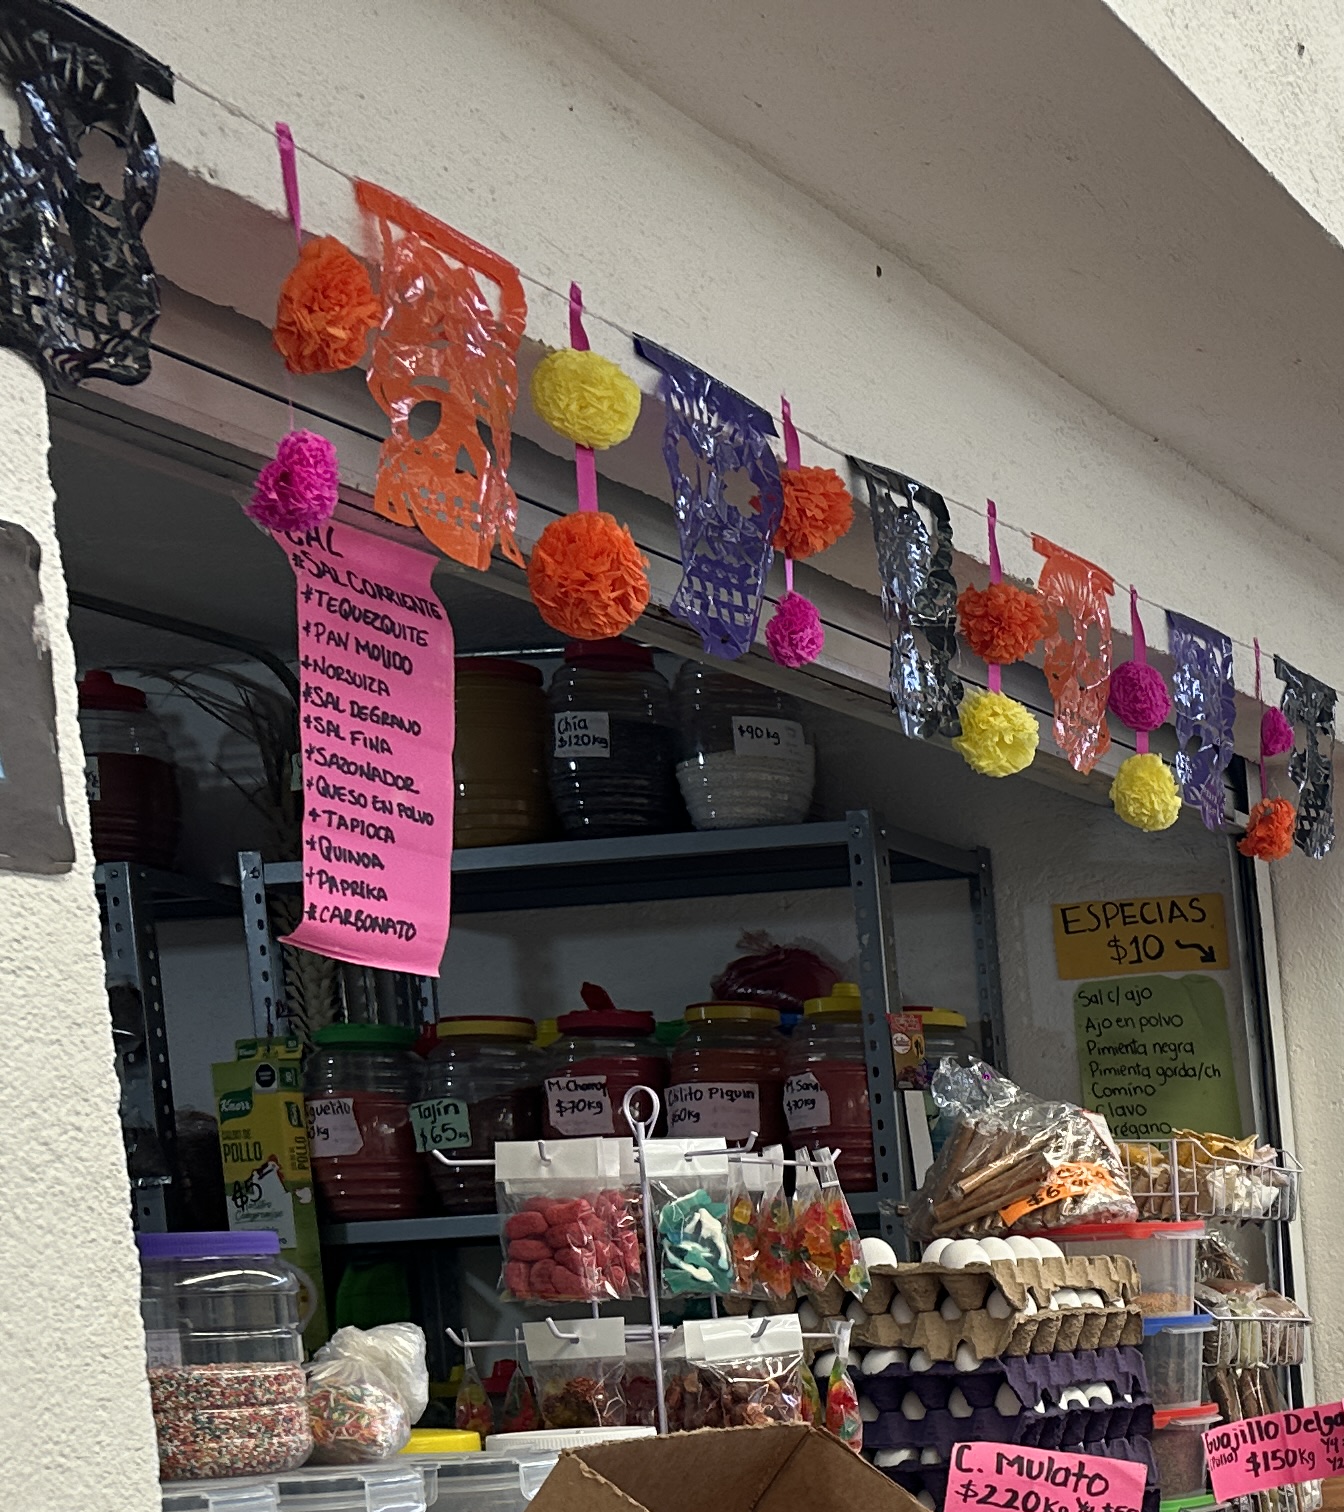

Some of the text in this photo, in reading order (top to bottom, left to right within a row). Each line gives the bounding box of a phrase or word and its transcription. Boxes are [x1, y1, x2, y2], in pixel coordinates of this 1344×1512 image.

[314, 588, 430, 648] TEQUEZQUITE
[314, 622, 350, 652] PAN
[313, 656, 392, 697] NORSUIZA
[311, 686, 347, 714] SAL
[313, 715, 394, 755] SAL FINA
[558, 716, 588, 735] Chía
[314, 747, 420, 795] SAZONADOR
[316, 775, 435, 827] QUESO EN POLVO
[322, 809, 396, 844] TAPIOCA
[318, 836, 386, 871] QUINOA
[319, 905, 418, 942] CARBONATO
[1060, 897, 1207, 935] ESPECIAS
[1107, 933, 1165, 965] $10
[1078, 987, 1104, 1007] Sal
[1085, 1012, 1184, 1037] Ajo en polvo
[1086, 1038, 1195, 1062] Pimienta negra
[1089, 1060, 1151, 1079] Pimienta
[411, 1101, 460, 1124] Tajín
[1094, 1102, 1148, 1118] Clavo
[223, 1141, 263, 1163] POLLO
[296, 1136, 309, 1171] POLLO
[1204, 1419, 1280, 1455] Guajillo
[956, 1444, 1109, 1497] C. Mulato
